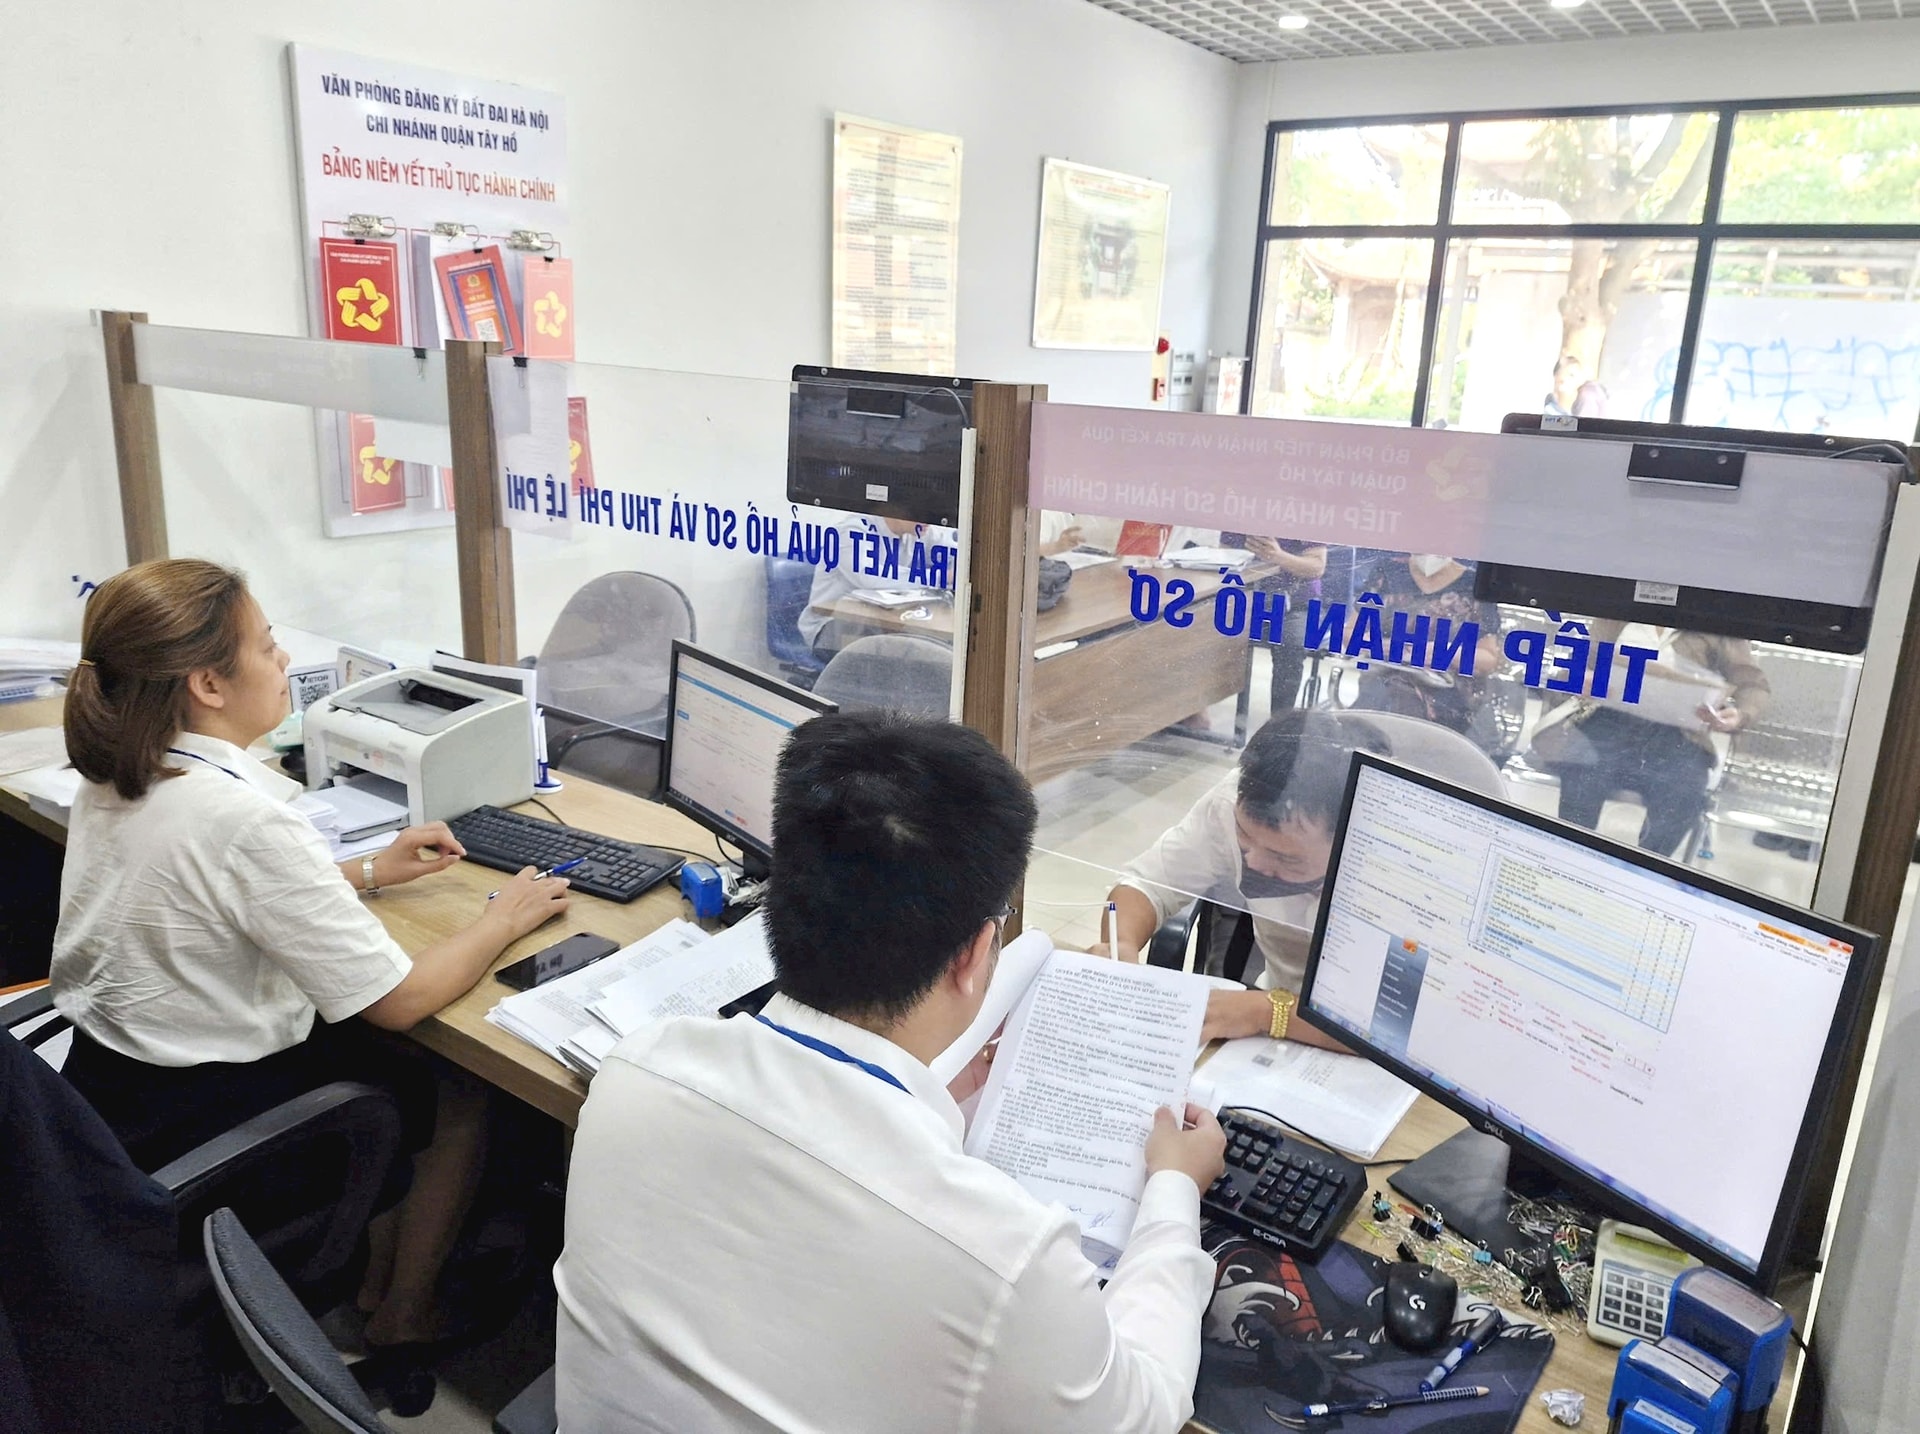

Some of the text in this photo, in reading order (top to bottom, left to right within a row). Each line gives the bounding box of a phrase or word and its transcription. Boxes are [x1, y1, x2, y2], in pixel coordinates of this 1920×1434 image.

[322, 73, 351, 98] VĂN
[355, 79, 401, 105] PHÒNG
[405, 88, 440, 113] ĐĂNG
[444, 94, 459, 116] KÝ
[489, 103, 508, 124] ĐAI
[511, 106, 527, 127] HÀ
[530, 109, 549, 134] NỘI
[366, 113, 389, 134] CHI
[393, 116, 437, 141] NHÁNH
[441, 123, 474, 151] QUẬN
[478, 129, 499, 151] TÂY
[322, 146, 556, 203] BẢNG NIÊM YẾT THỦ TỤC HÀNH CHÍNH
[1484, 1120, 1505, 1139] DELL
